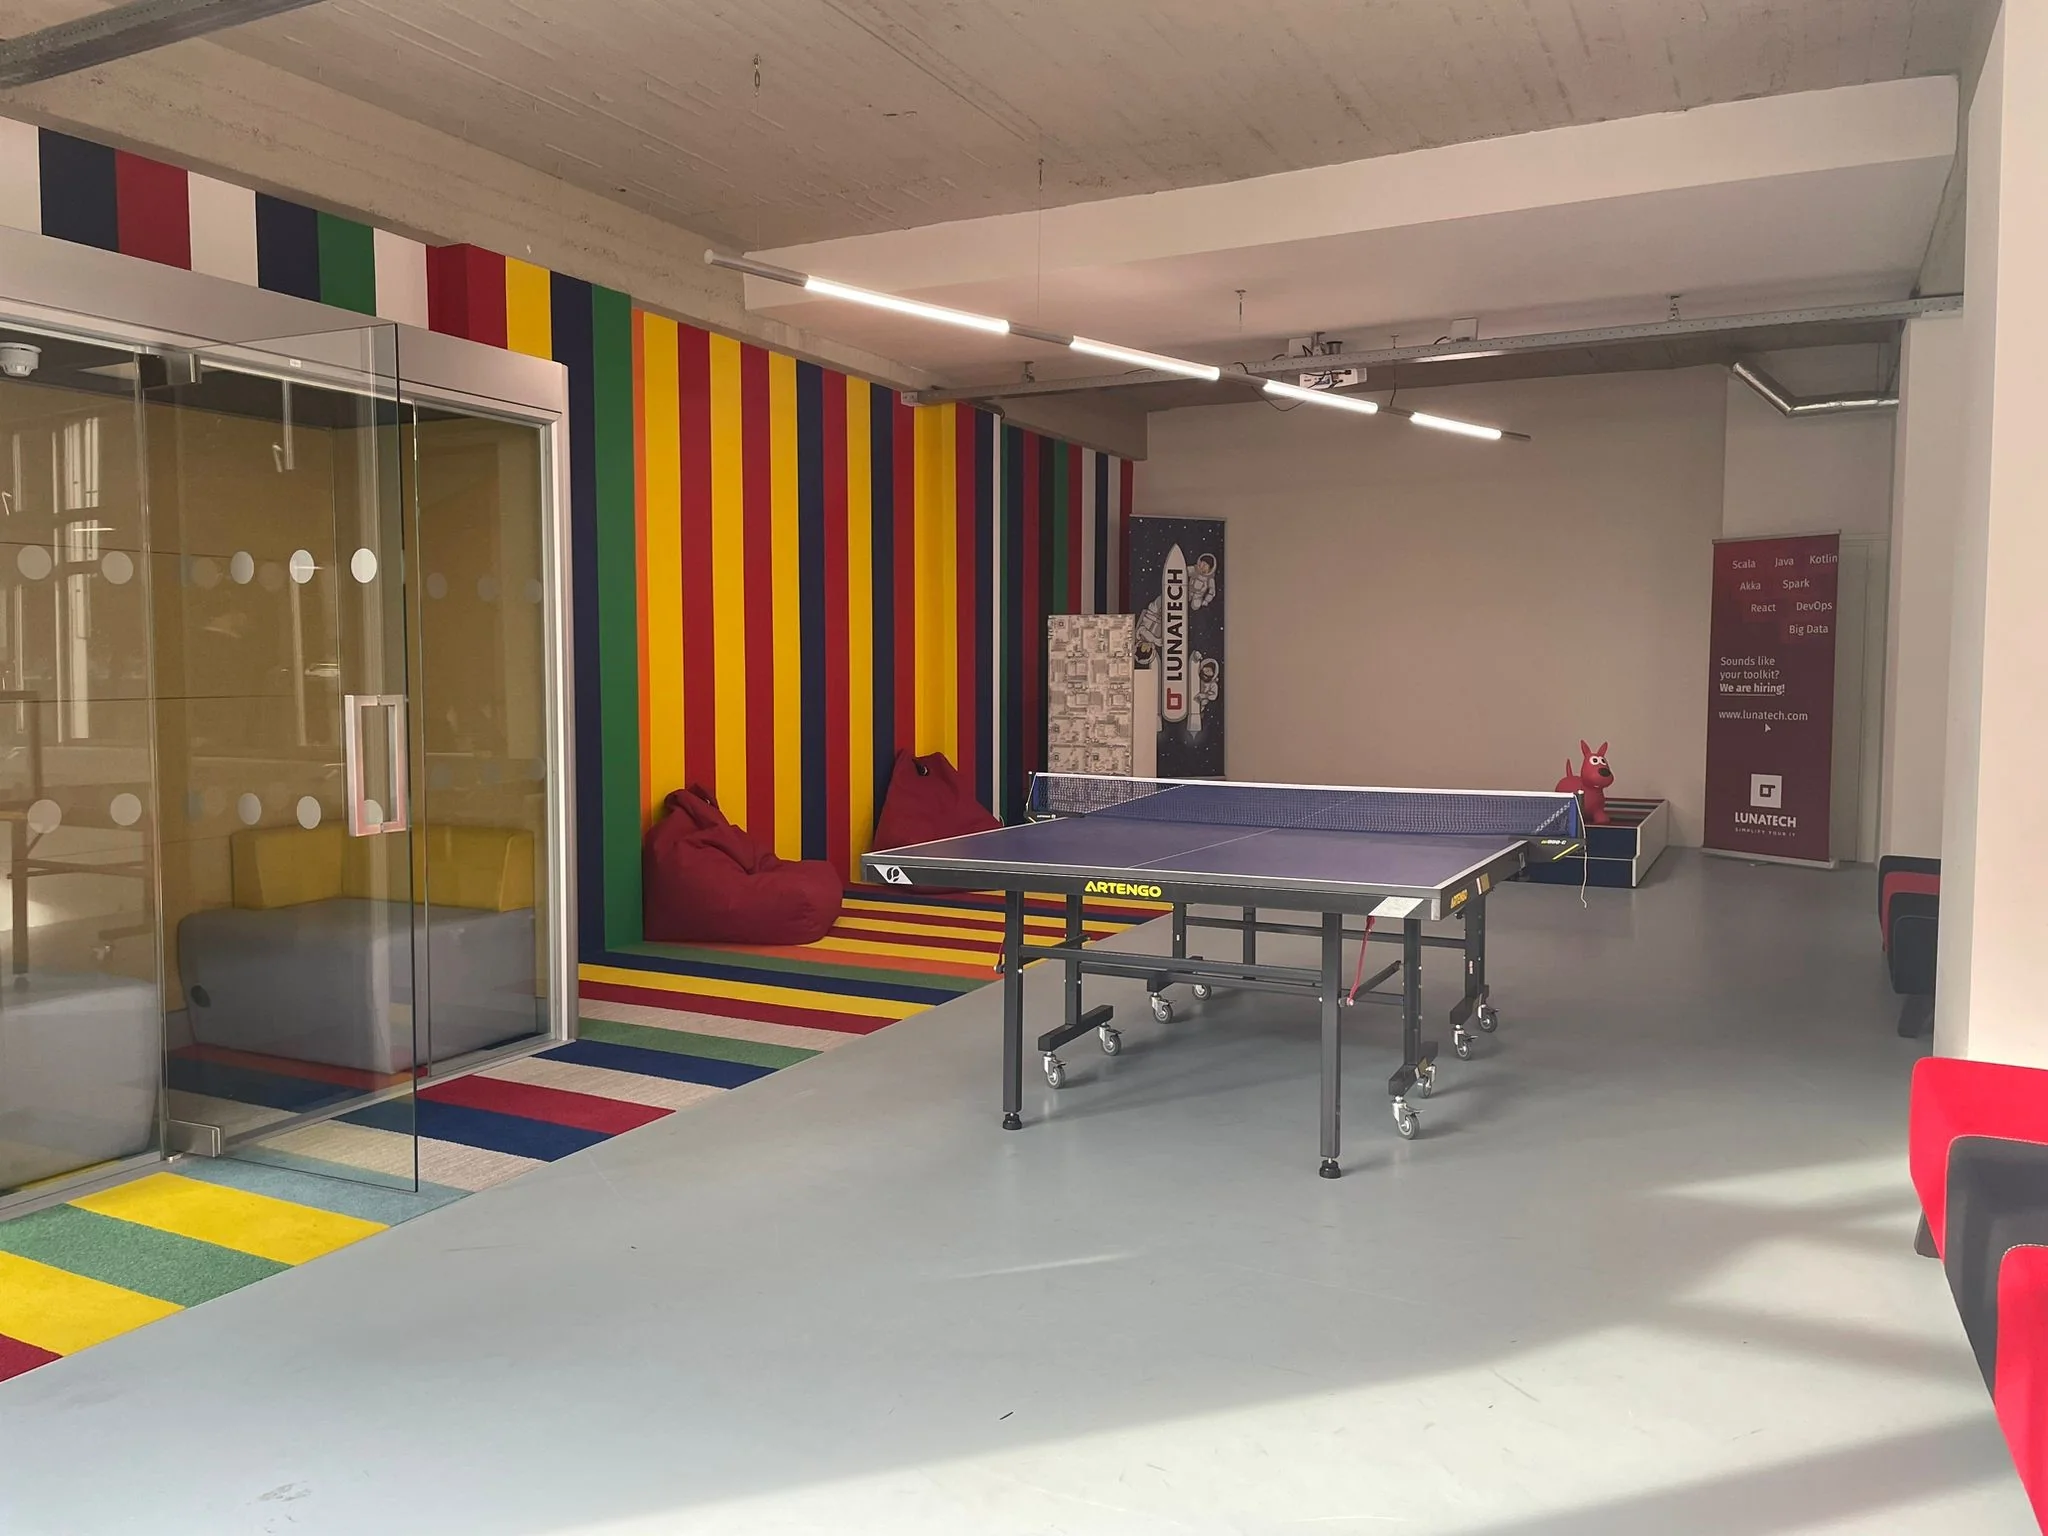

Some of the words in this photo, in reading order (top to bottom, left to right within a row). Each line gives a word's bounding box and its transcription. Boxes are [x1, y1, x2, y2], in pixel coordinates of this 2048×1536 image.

[1732, 559, 1756, 569] Scala
[1775, 557, 1794, 567] Java
[1809, 554, 1838, 564] Kotlin
[1740, 582, 1761, 591] Akka
[1783, 579, 1810, 590] Spark
[1751, 604, 1776, 612] React
[1796, 601, 1833, 612] DevOps
[1167, 569, 1183, 681] LUNATECH
[1789, 625, 1804, 636] Big
[1807, 624, 1829, 634] Data
[1720, 656, 1756, 666] Sounds
[1758, 656, 1775, 666] like
[1720, 671, 1741, 681] your
[1743, 669, 1780, 680] toolkit?
[1720, 683, 1734, 692] We
[1736, 685, 1752, 693] are
[1754, 682, 1785, 695] hiring!
[1719, 709, 1808, 721] www.lunatech.com
[1735, 812, 1797, 828] LUNATECH
[1085, 880, 1162, 898] ARTENGO
